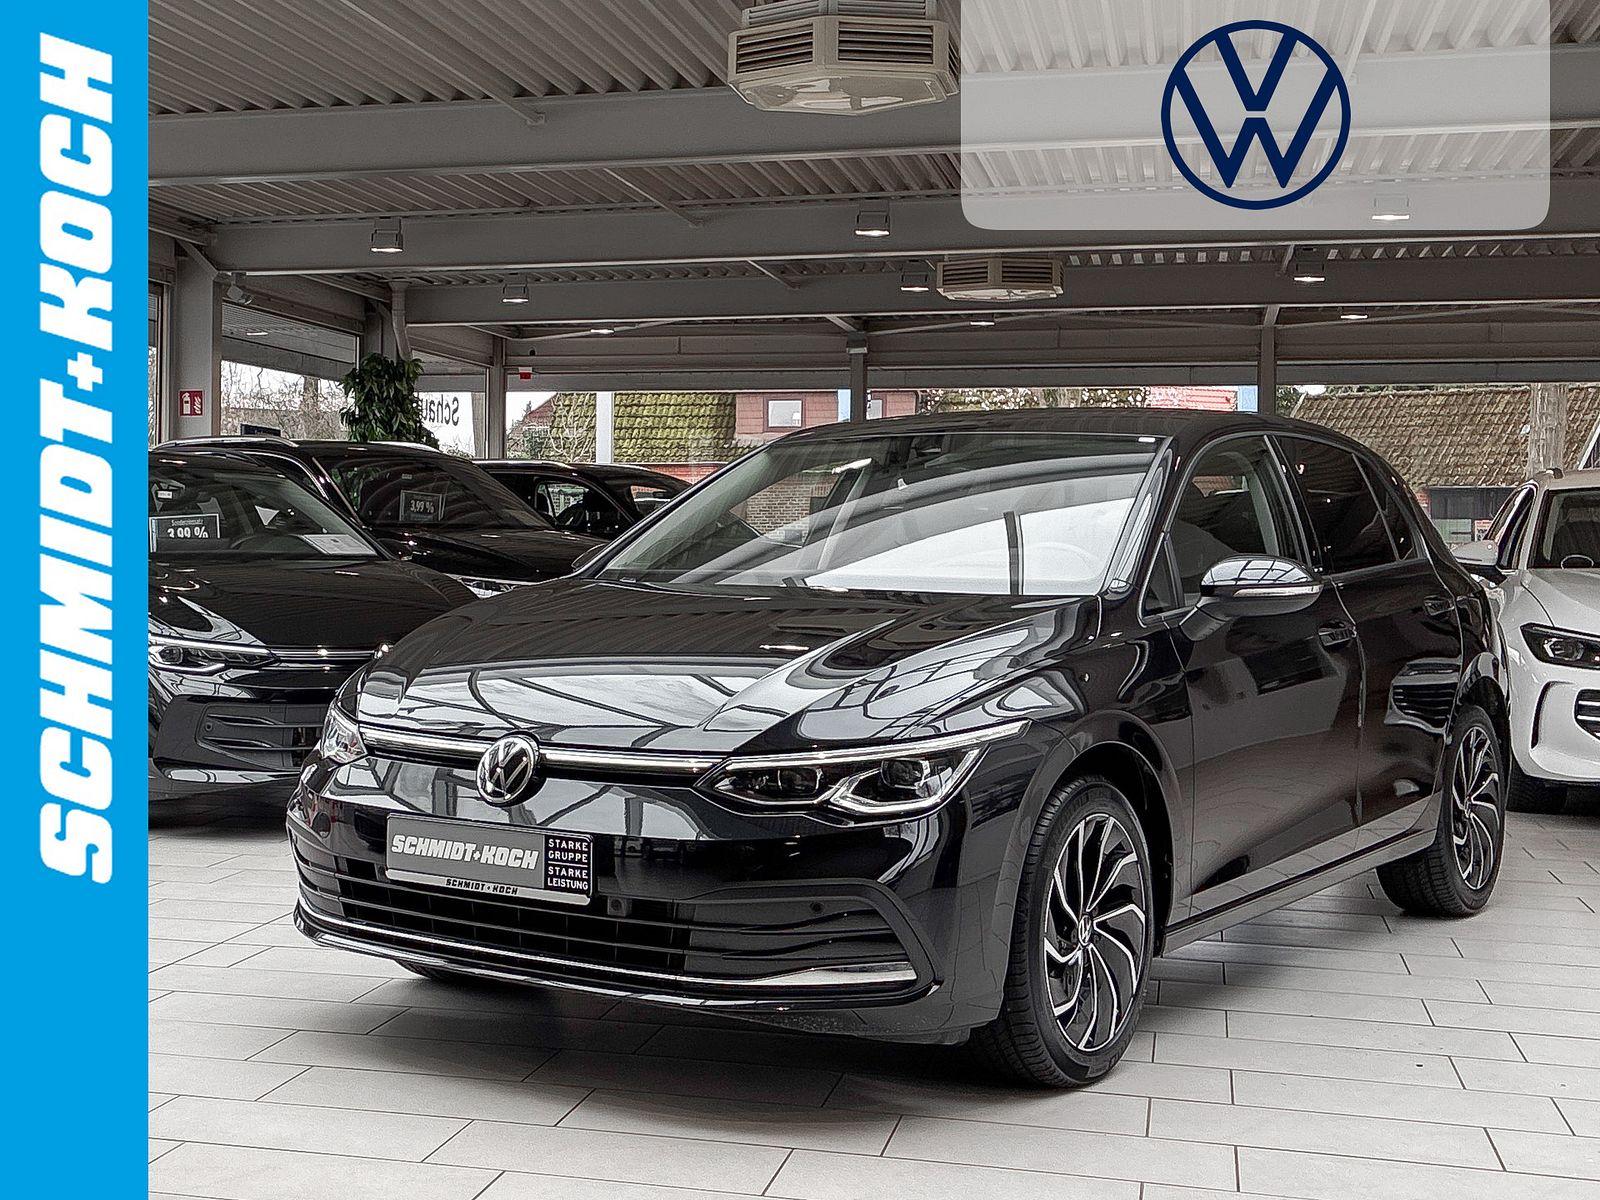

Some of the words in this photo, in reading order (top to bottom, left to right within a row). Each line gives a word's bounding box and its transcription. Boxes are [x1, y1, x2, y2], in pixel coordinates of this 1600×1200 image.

[548, 839, 589, 851] STARKE
[548, 851, 588, 863] GRUPPE
[548, 866, 589, 879] STARKE
[547, 878, 589, 890] LEISTUNG
